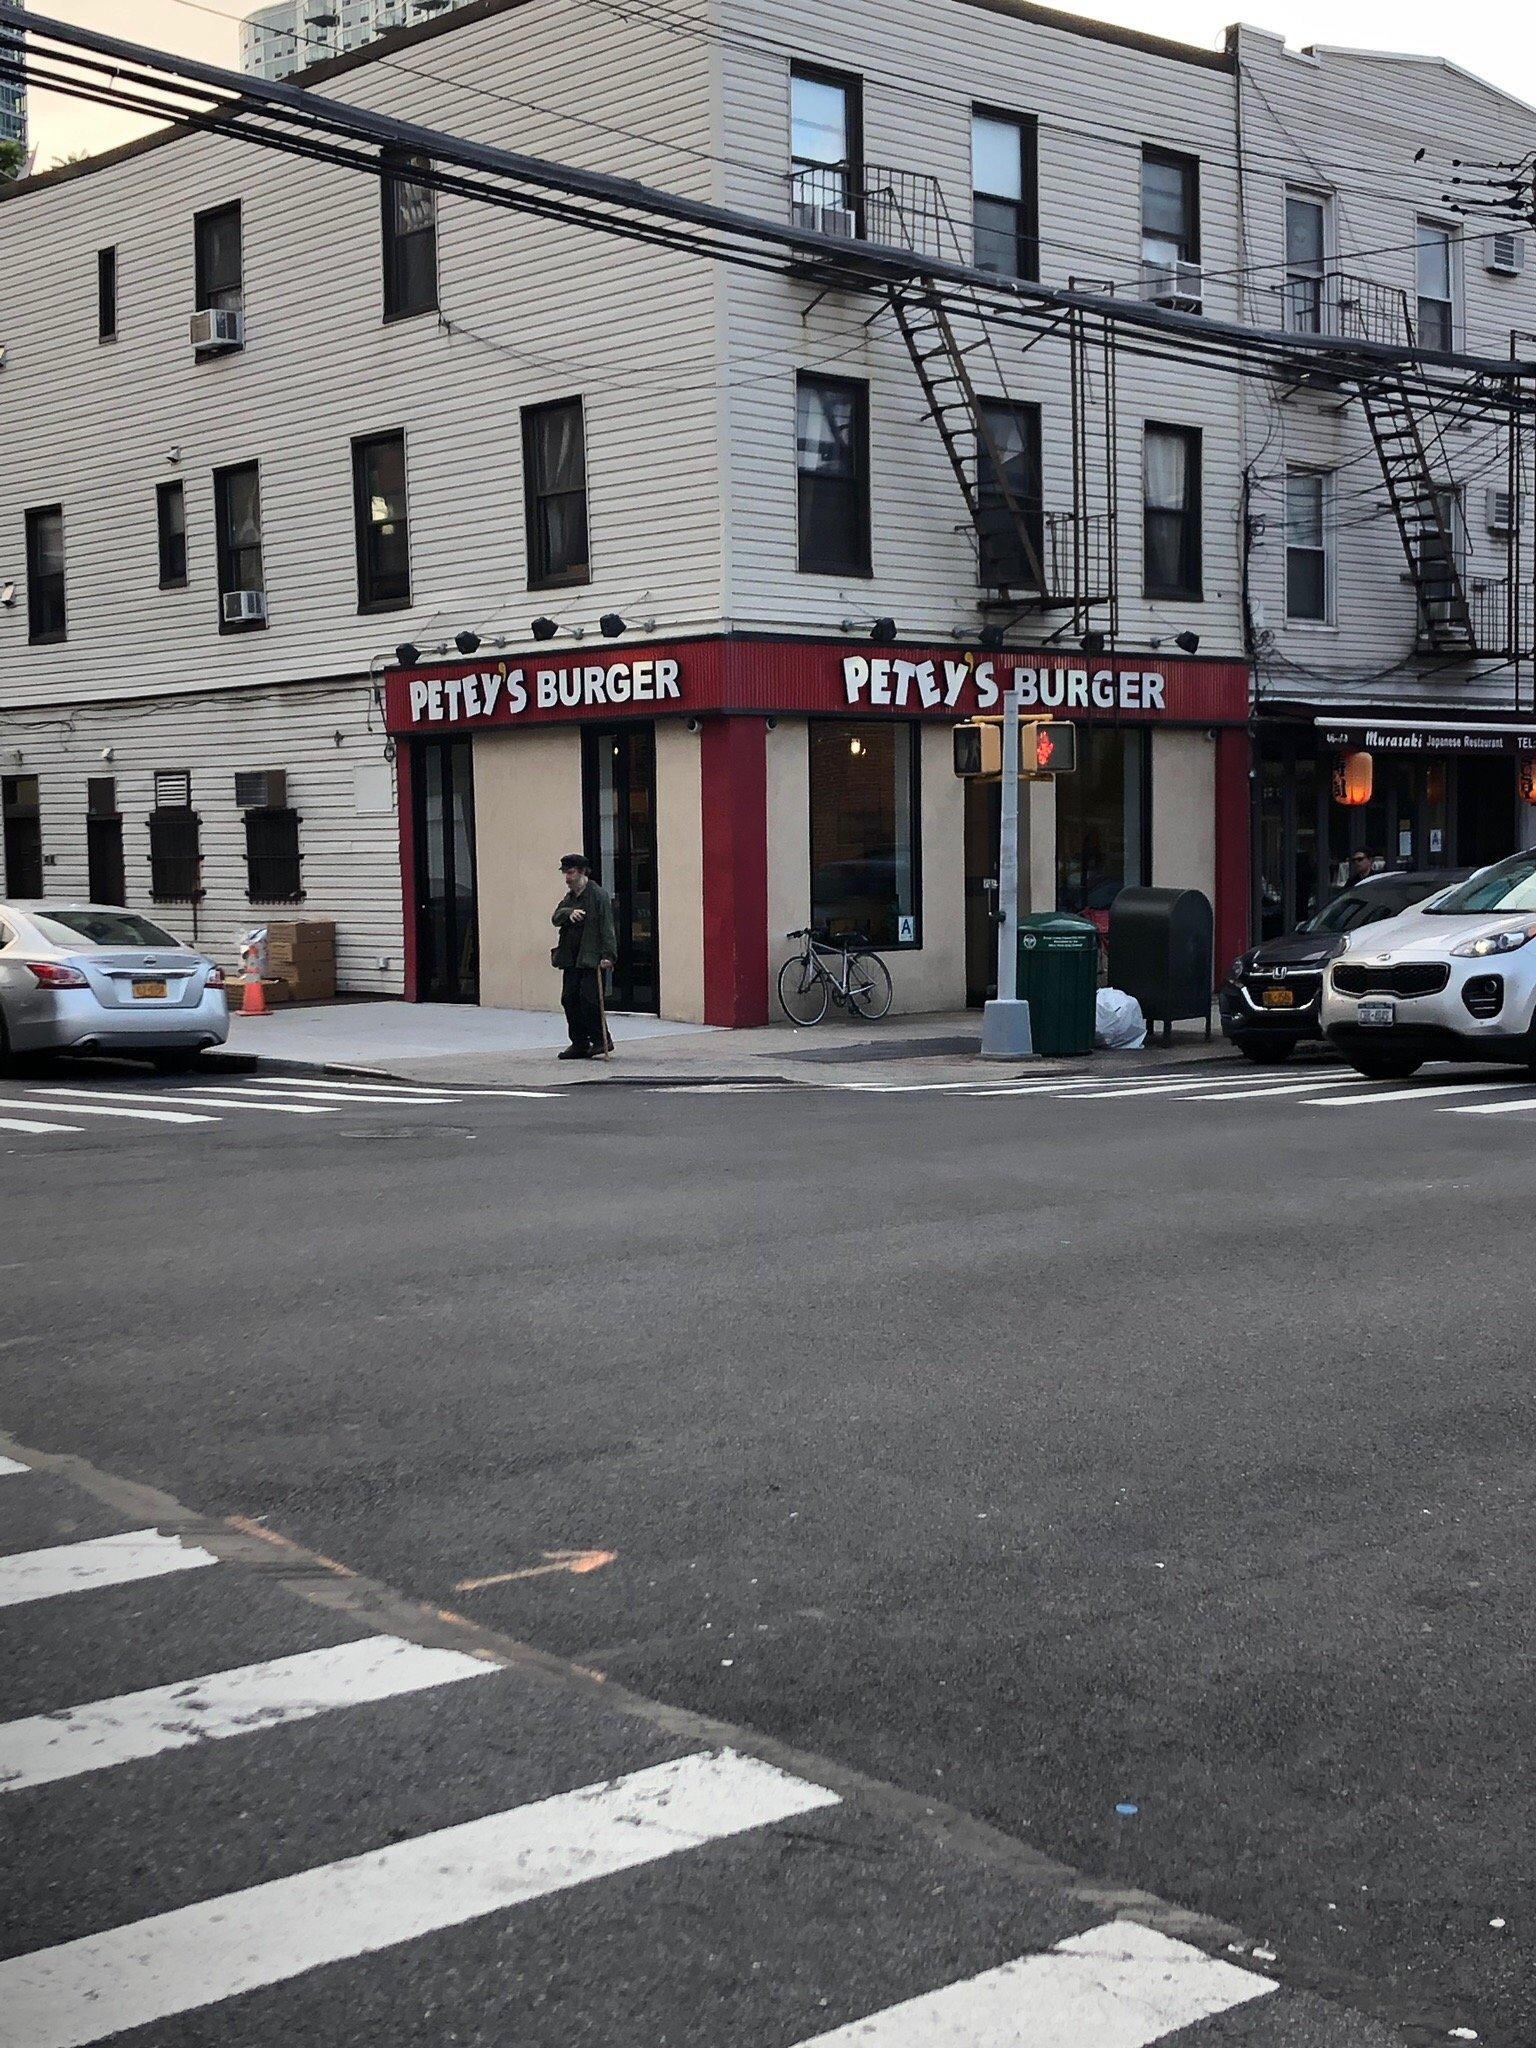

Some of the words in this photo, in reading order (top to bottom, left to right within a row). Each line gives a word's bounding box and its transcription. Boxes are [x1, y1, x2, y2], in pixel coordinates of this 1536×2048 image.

[409, 661, 527, 722] PETEY'S
[536, 659, 681, 708] BURGER
[843, 651, 998, 709] PETEY'S
[1014, 666, 1166, 709] BURGER
[1365, 730, 1423, 748] Murasaki
[1426, 734, 1462, 749] Japanese
[1463, 735, 1504, 748] Restaurant
[901, 918, 912, 934] A
